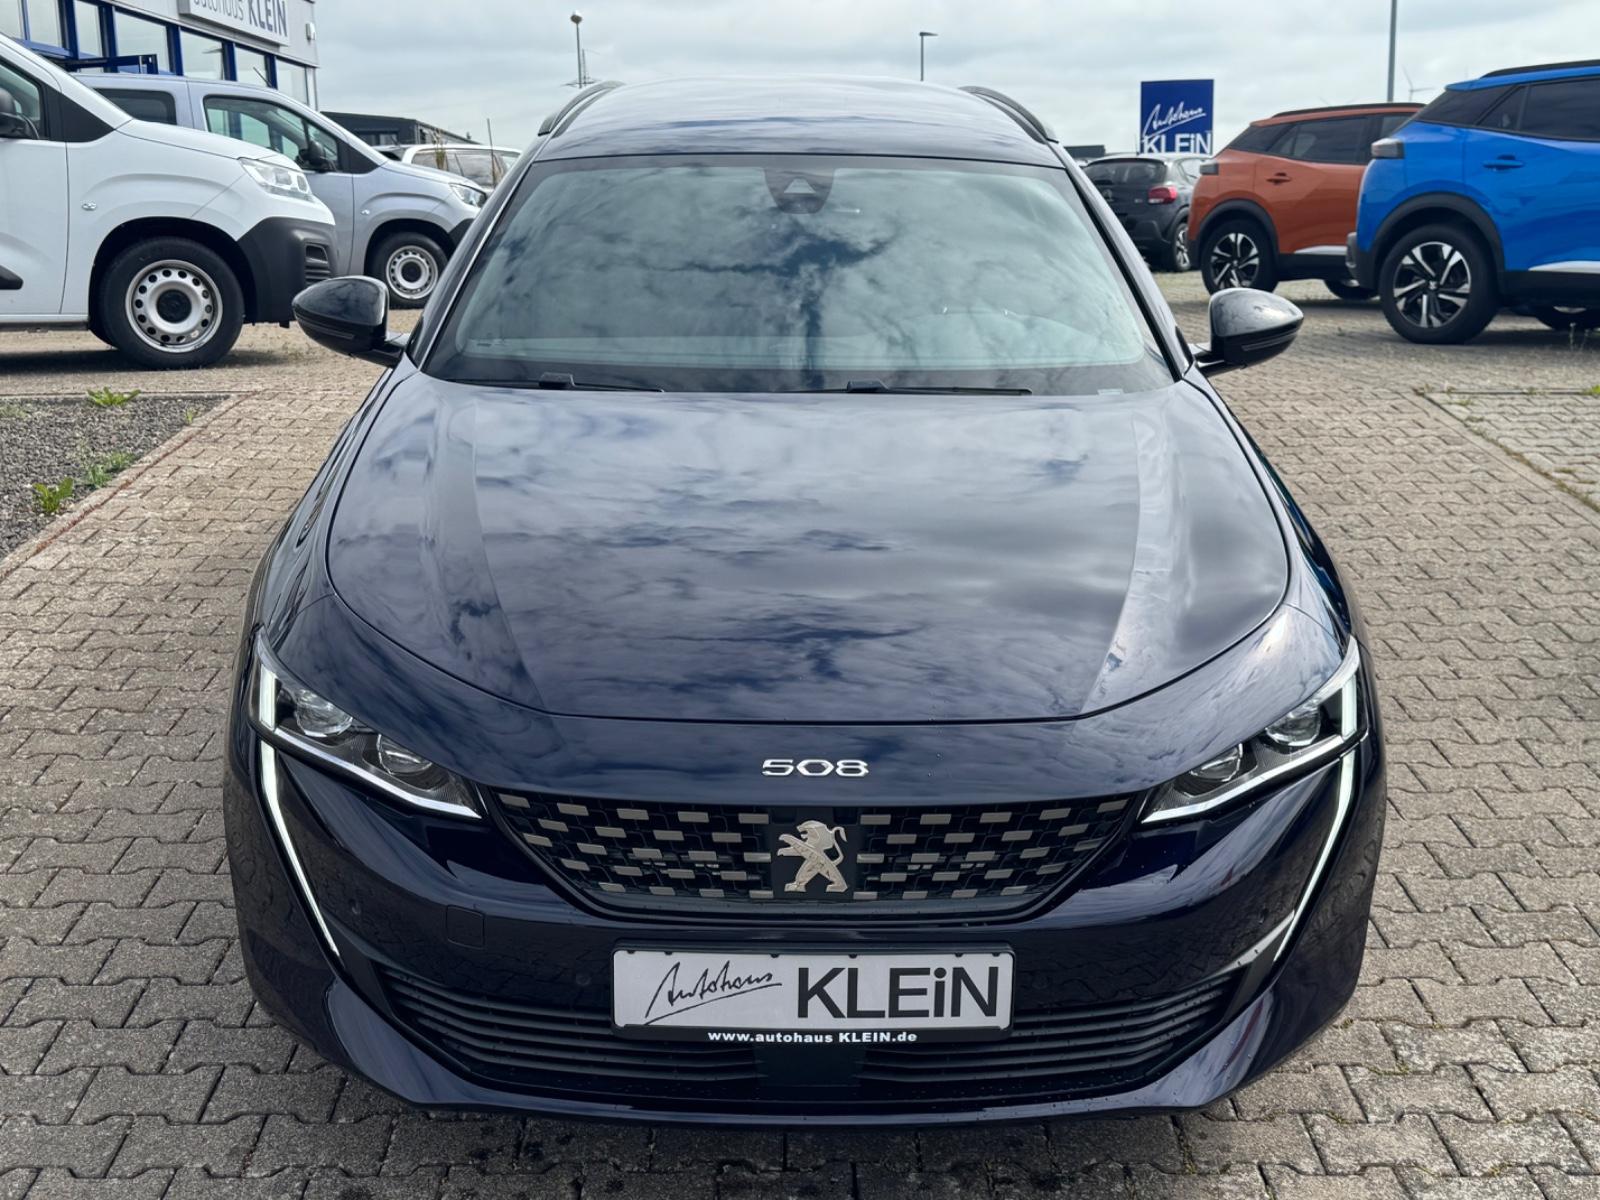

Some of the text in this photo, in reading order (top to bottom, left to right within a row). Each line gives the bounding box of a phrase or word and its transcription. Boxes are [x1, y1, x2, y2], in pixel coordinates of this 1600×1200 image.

[248, 0, 288, 37] KLEIN
[762, 758, 869, 777] 508
[645, 960, 774, 1018] Autohaus
[707, 1031, 918, 1044] www.autohaus KLEIN.de
